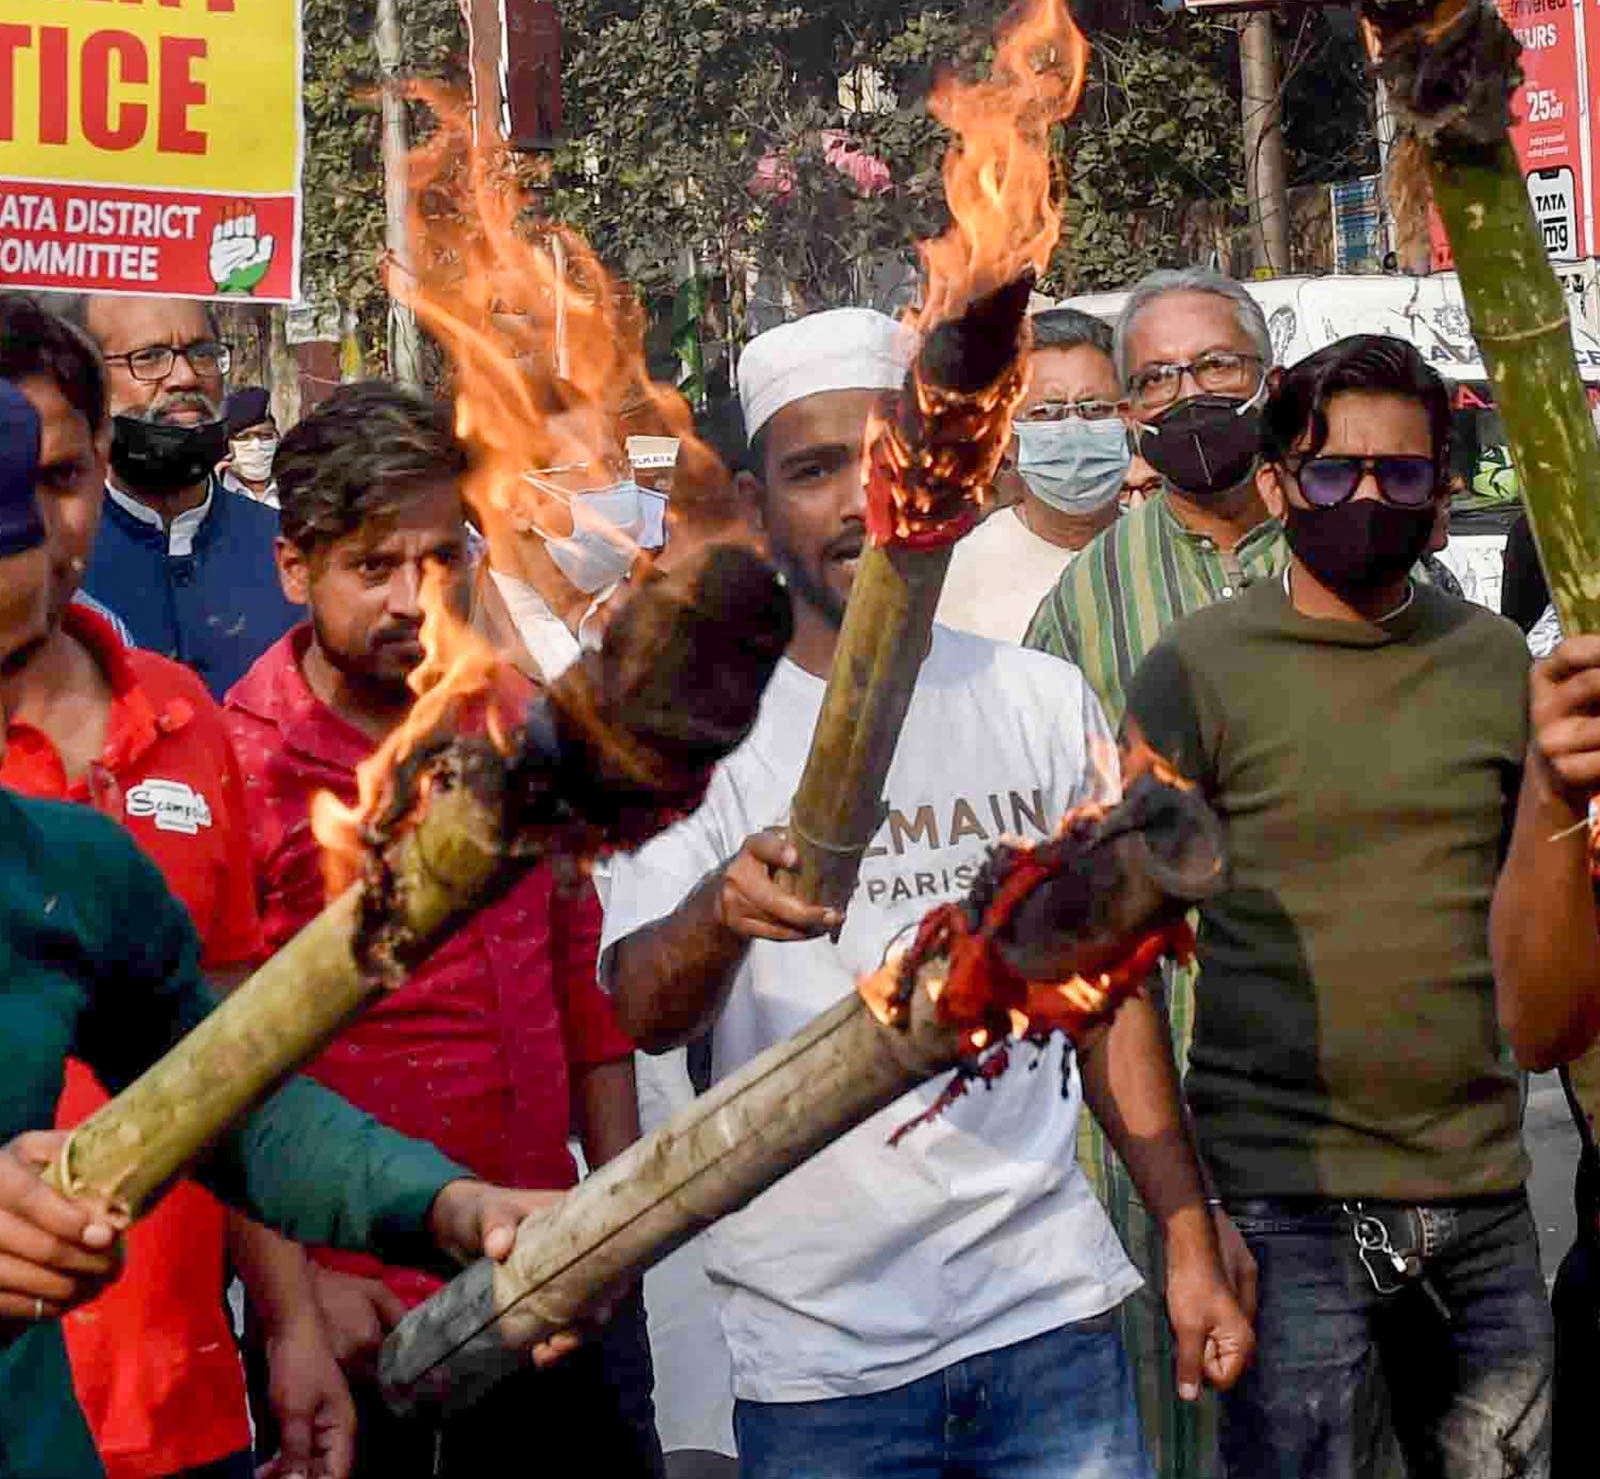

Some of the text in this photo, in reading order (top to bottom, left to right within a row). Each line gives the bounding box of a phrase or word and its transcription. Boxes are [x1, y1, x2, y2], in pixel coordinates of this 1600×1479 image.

[64, 198, 202, 240] DISTRICT
[1535, 193, 1566, 213] TATA
[1541, 224, 1569, 252] mg
[865, 789, 1050, 858] MAIN
[867, 864, 978, 904] PARIS
